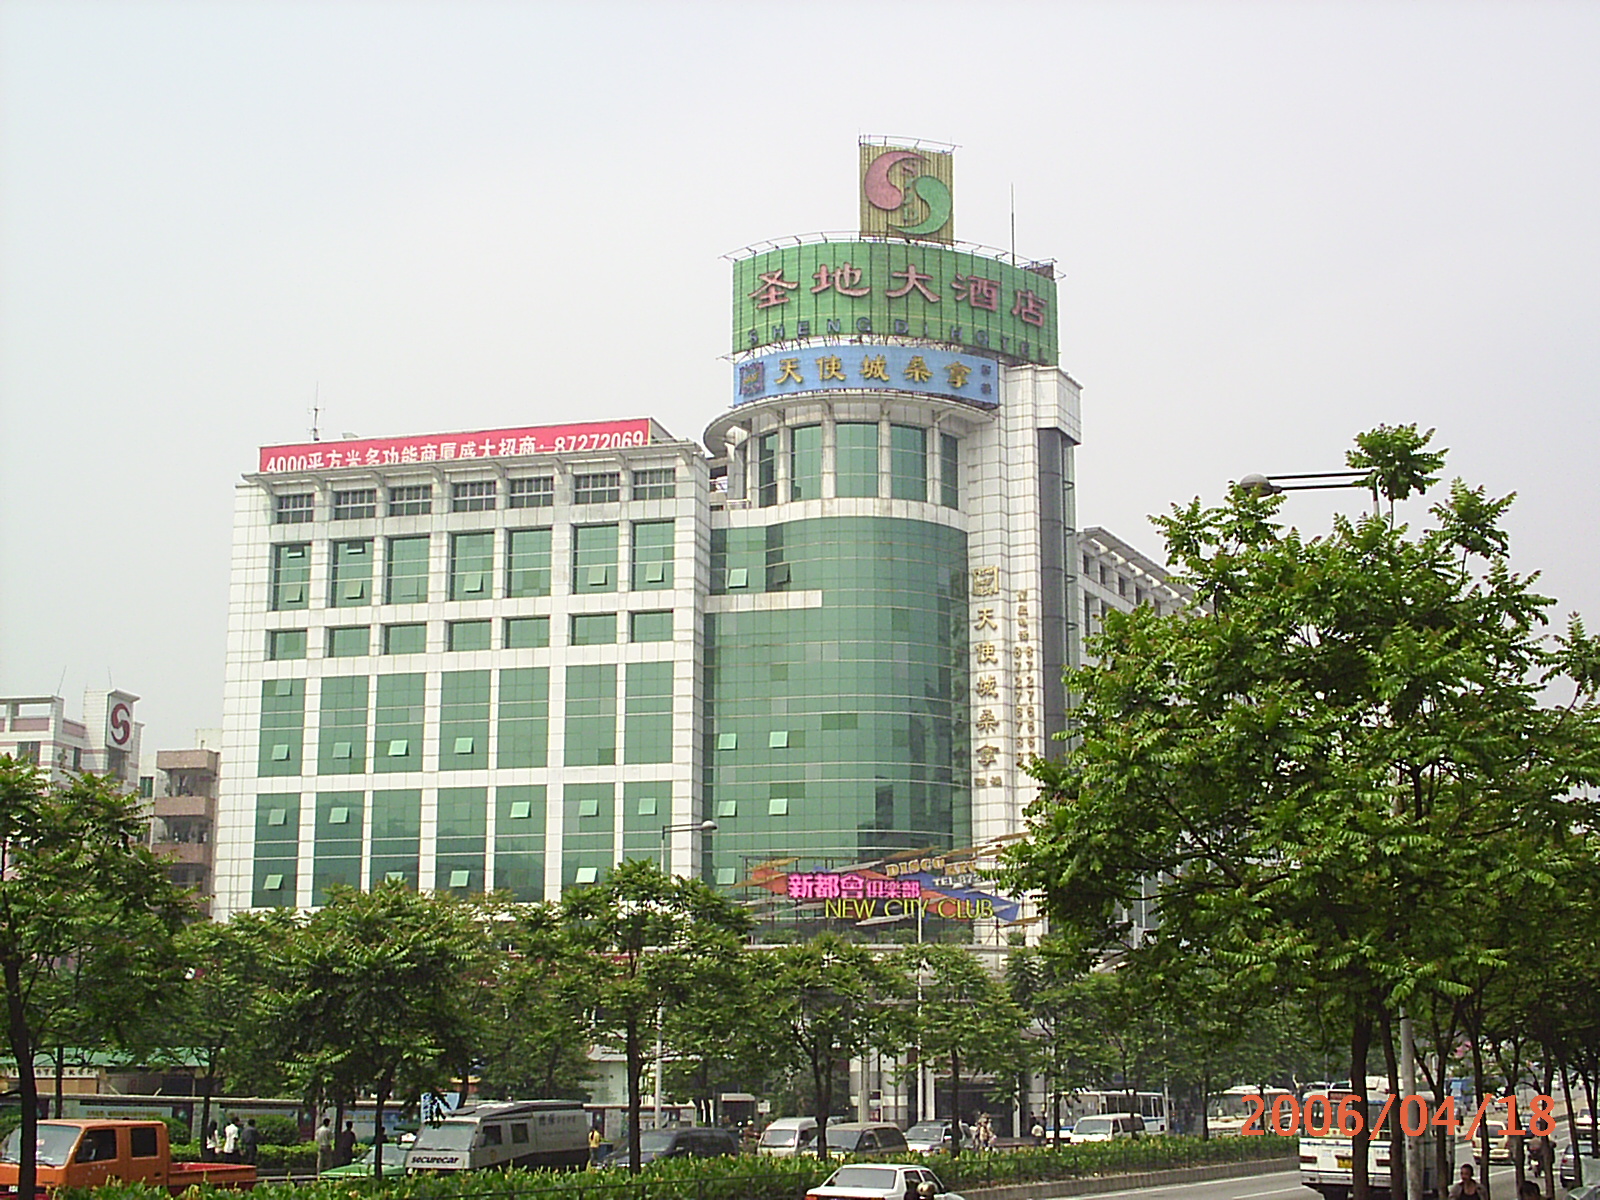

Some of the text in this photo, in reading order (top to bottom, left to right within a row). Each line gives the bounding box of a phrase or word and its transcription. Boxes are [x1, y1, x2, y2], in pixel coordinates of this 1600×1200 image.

[748, 262, 1047, 327] 圣地大酒店
[748, 316, 872, 344] SHENG
[775, 354, 972, 389] 天使城桑拿
[974, 608, 1000, 767] 天使城桑拿
[885, 855, 945, 877] DISCO
[825, 899, 994, 919] NEW CITY CLUB
[411, 1155, 459, 1165] securecar
